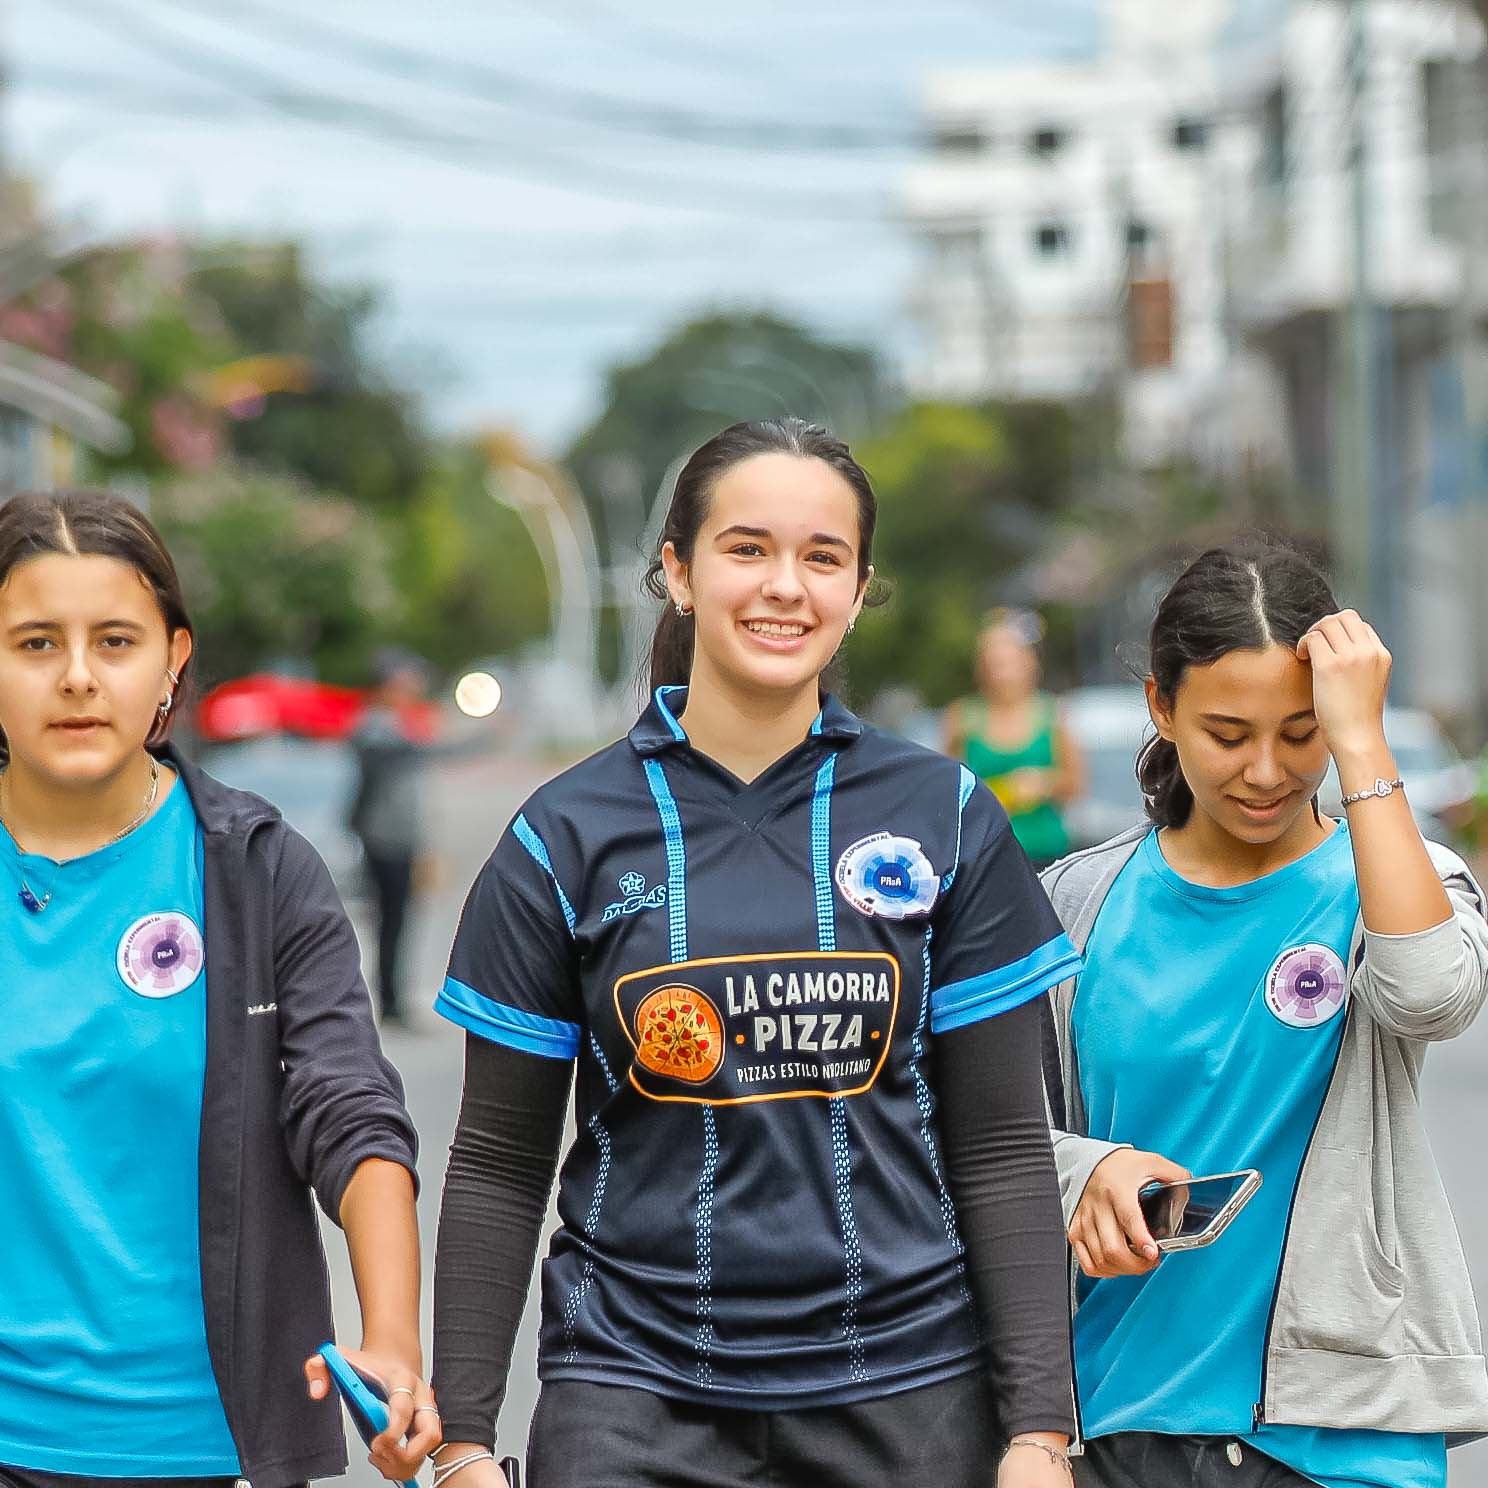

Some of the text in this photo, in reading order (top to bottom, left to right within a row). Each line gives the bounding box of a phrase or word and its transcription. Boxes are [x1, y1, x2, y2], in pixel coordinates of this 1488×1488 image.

[725, 972, 890, 1017] LA CAMORRA
[754, 1013, 862, 1052] PIZZA
[736, 1057, 871, 1082] PIZZAS ESTILO NPOLITANO
